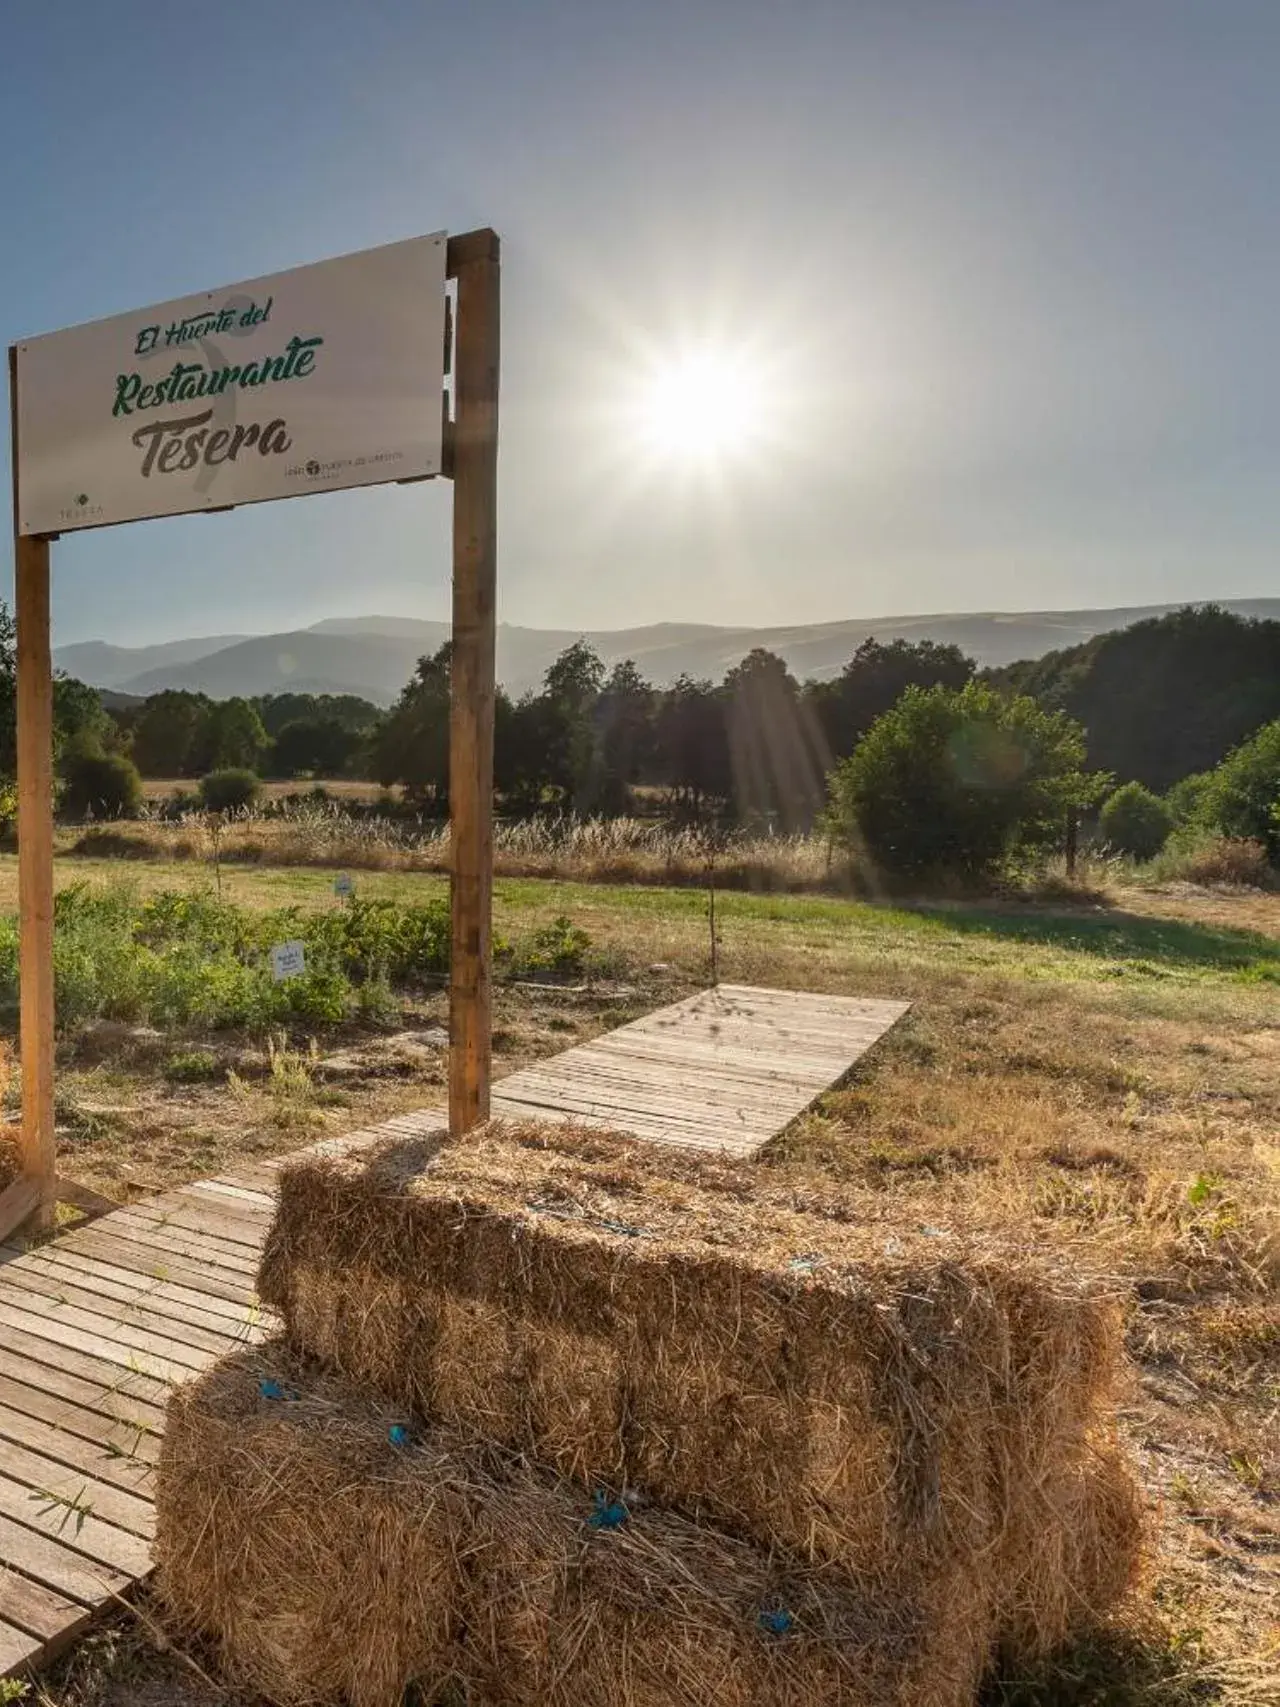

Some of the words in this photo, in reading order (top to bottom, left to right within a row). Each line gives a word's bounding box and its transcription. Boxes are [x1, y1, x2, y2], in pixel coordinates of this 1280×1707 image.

[134, 325, 160, 355] El
[165, 308, 236, 346] Huerto
[239, 297, 273, 328] del
[112, 336, 323, 417] Restaurante
[131, 409, 293, 478] Tesera
